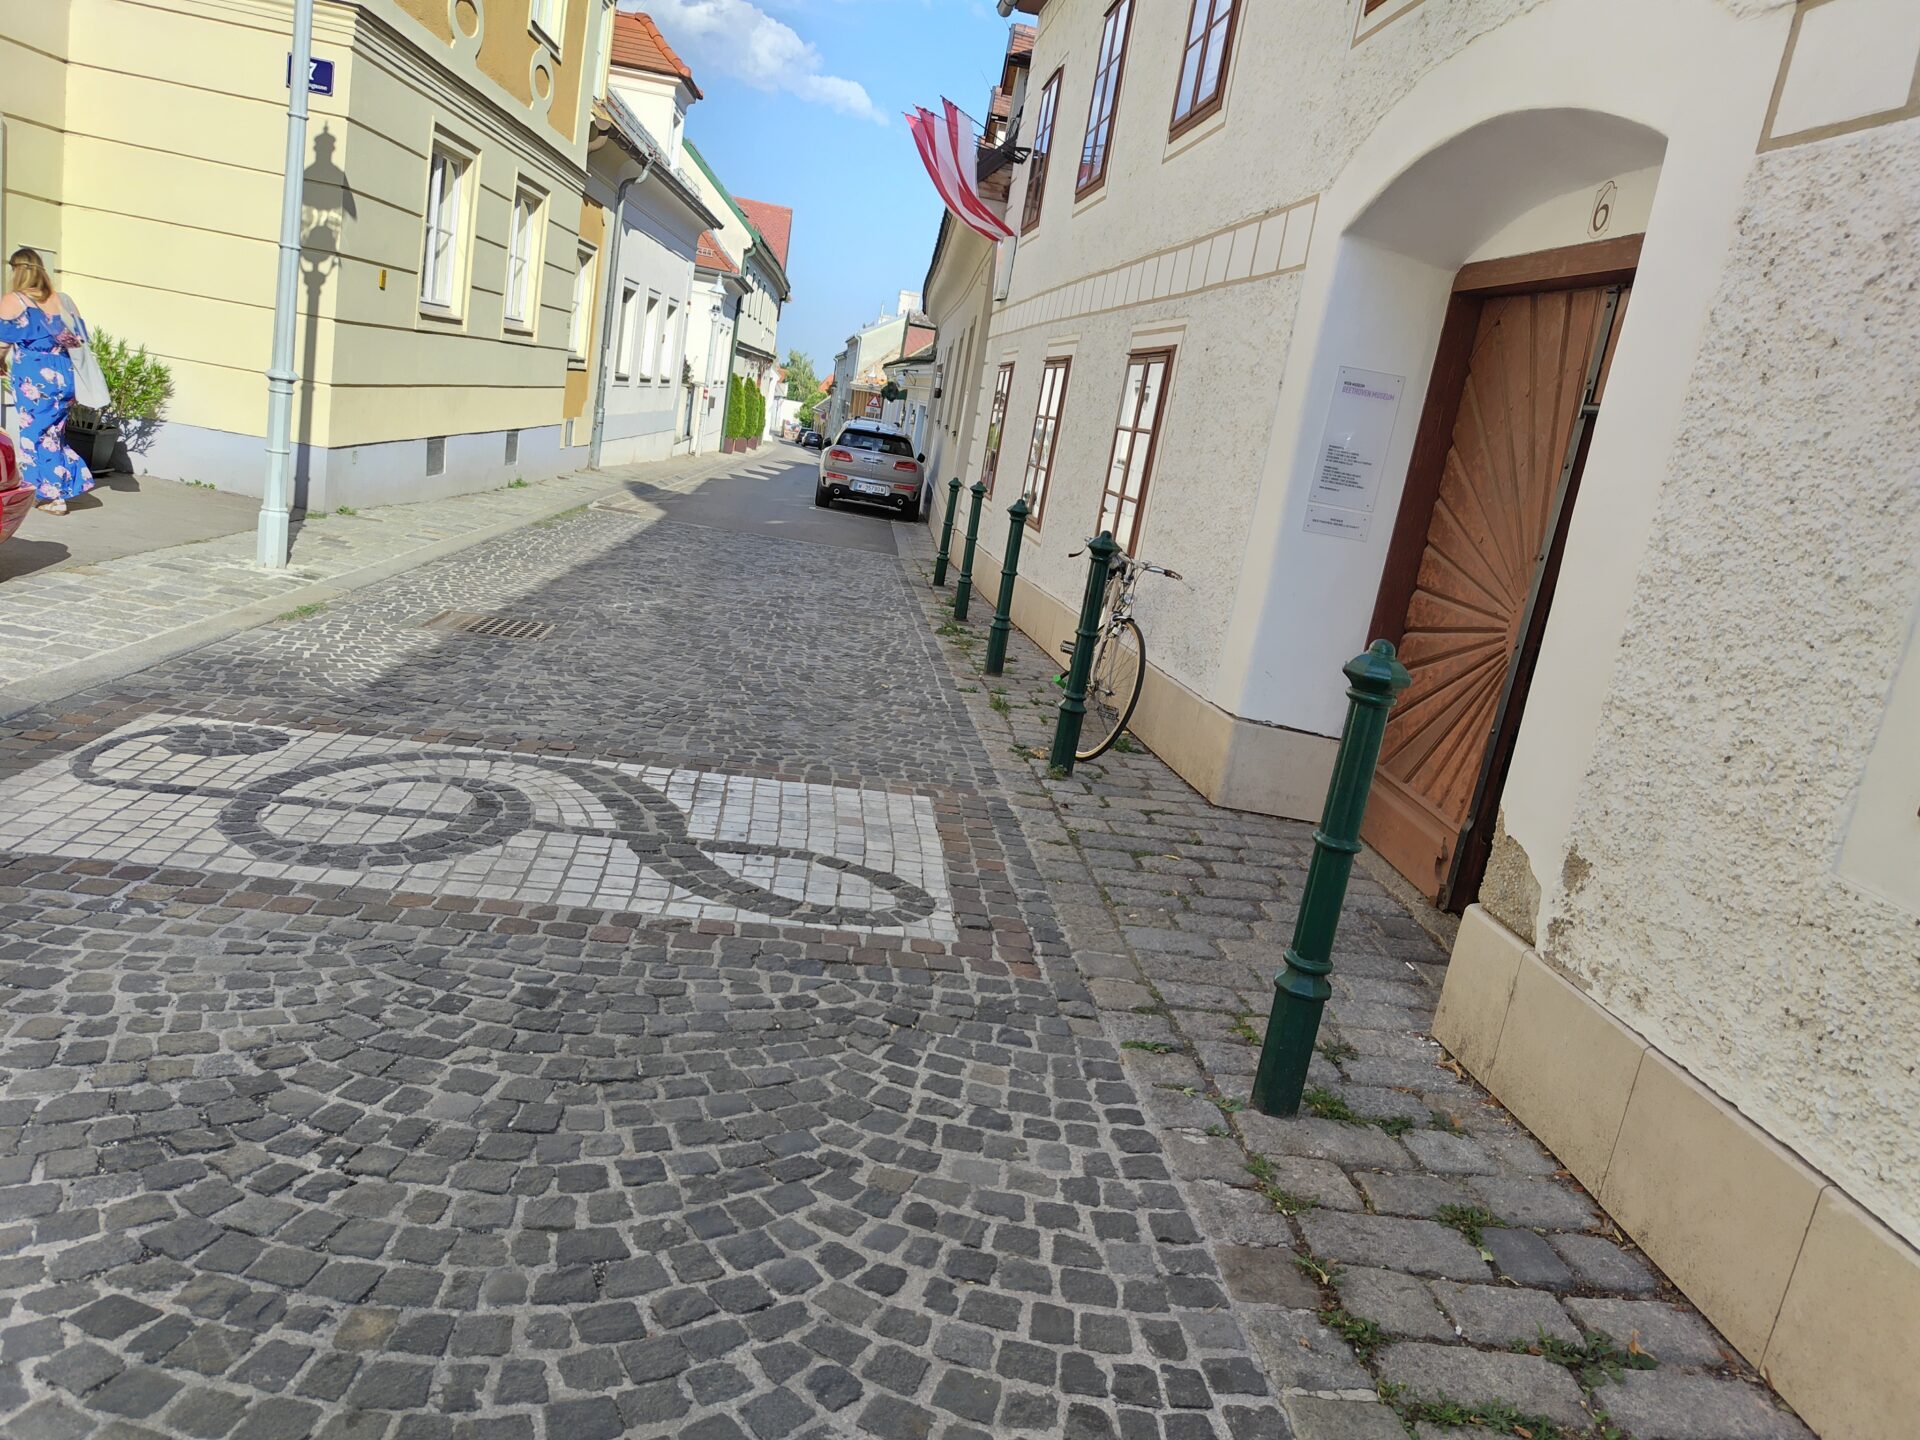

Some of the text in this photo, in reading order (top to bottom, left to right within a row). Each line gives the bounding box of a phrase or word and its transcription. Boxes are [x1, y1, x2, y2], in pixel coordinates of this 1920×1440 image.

[1592, 184, 1612, 232] 6
[1341, 385, 1395, 401] BEETHOVEN MUSEUM
